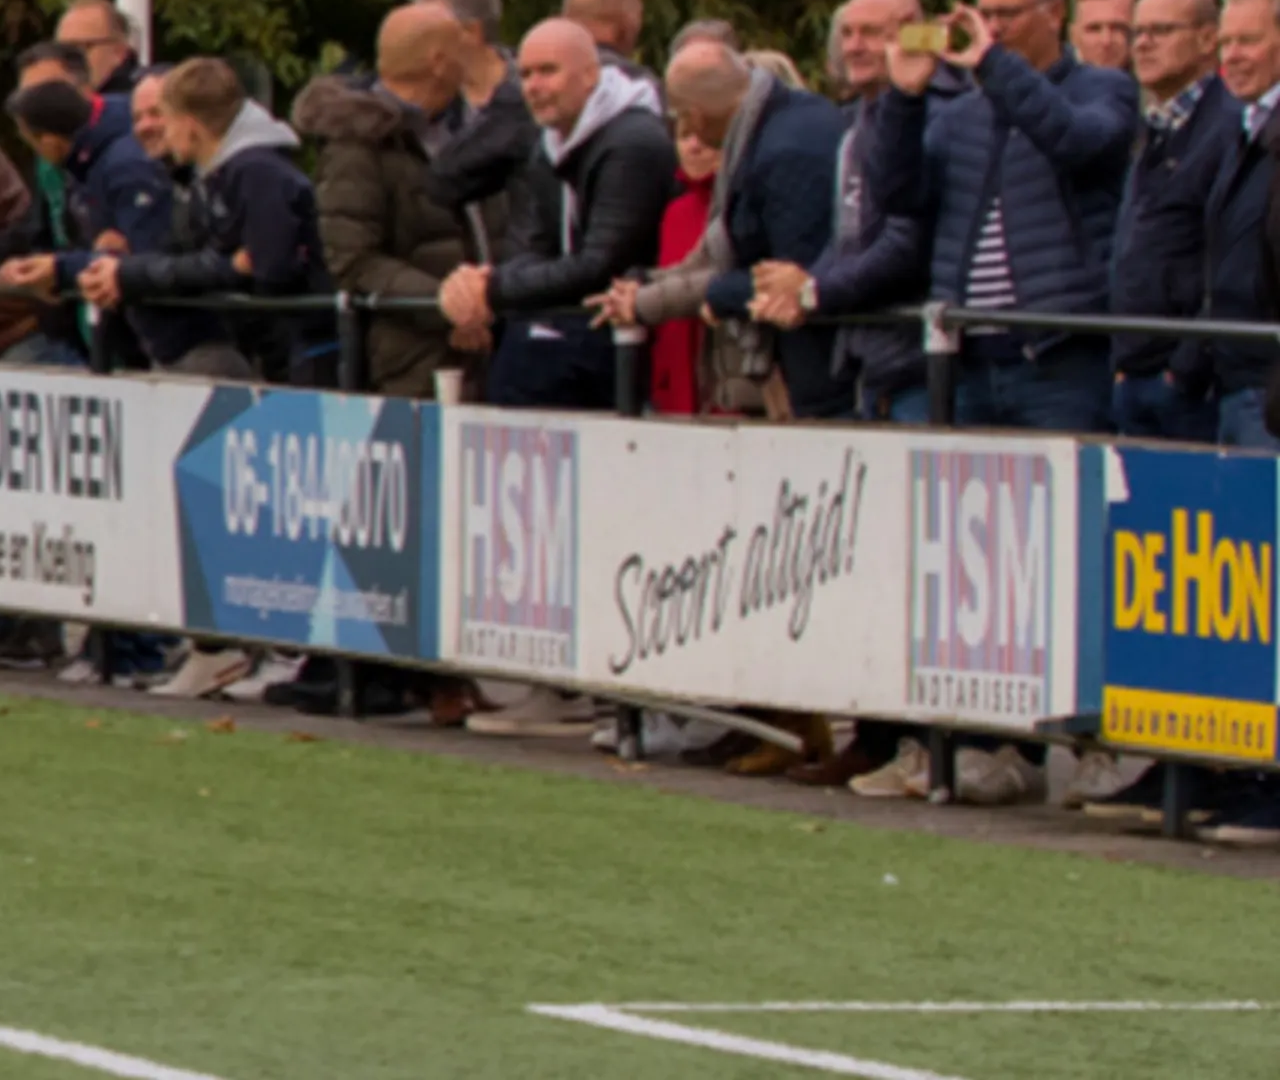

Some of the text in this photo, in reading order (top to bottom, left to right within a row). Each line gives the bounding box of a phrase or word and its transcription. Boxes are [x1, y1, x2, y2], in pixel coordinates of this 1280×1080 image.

[46, 392, 124, 501] VEEN
[10, 532, 28, 581] en
[464, 447, 572, 607] HSM
[608, 446, 868, 676] Scoort altijd!
[914, 476, 1046, 648] HSM
[1113, 507, 1272, 645] DE HON
[915, 674, 1041, 715] NOTARISSEN
[1108, 697, 1267, 751] bouwmachines
